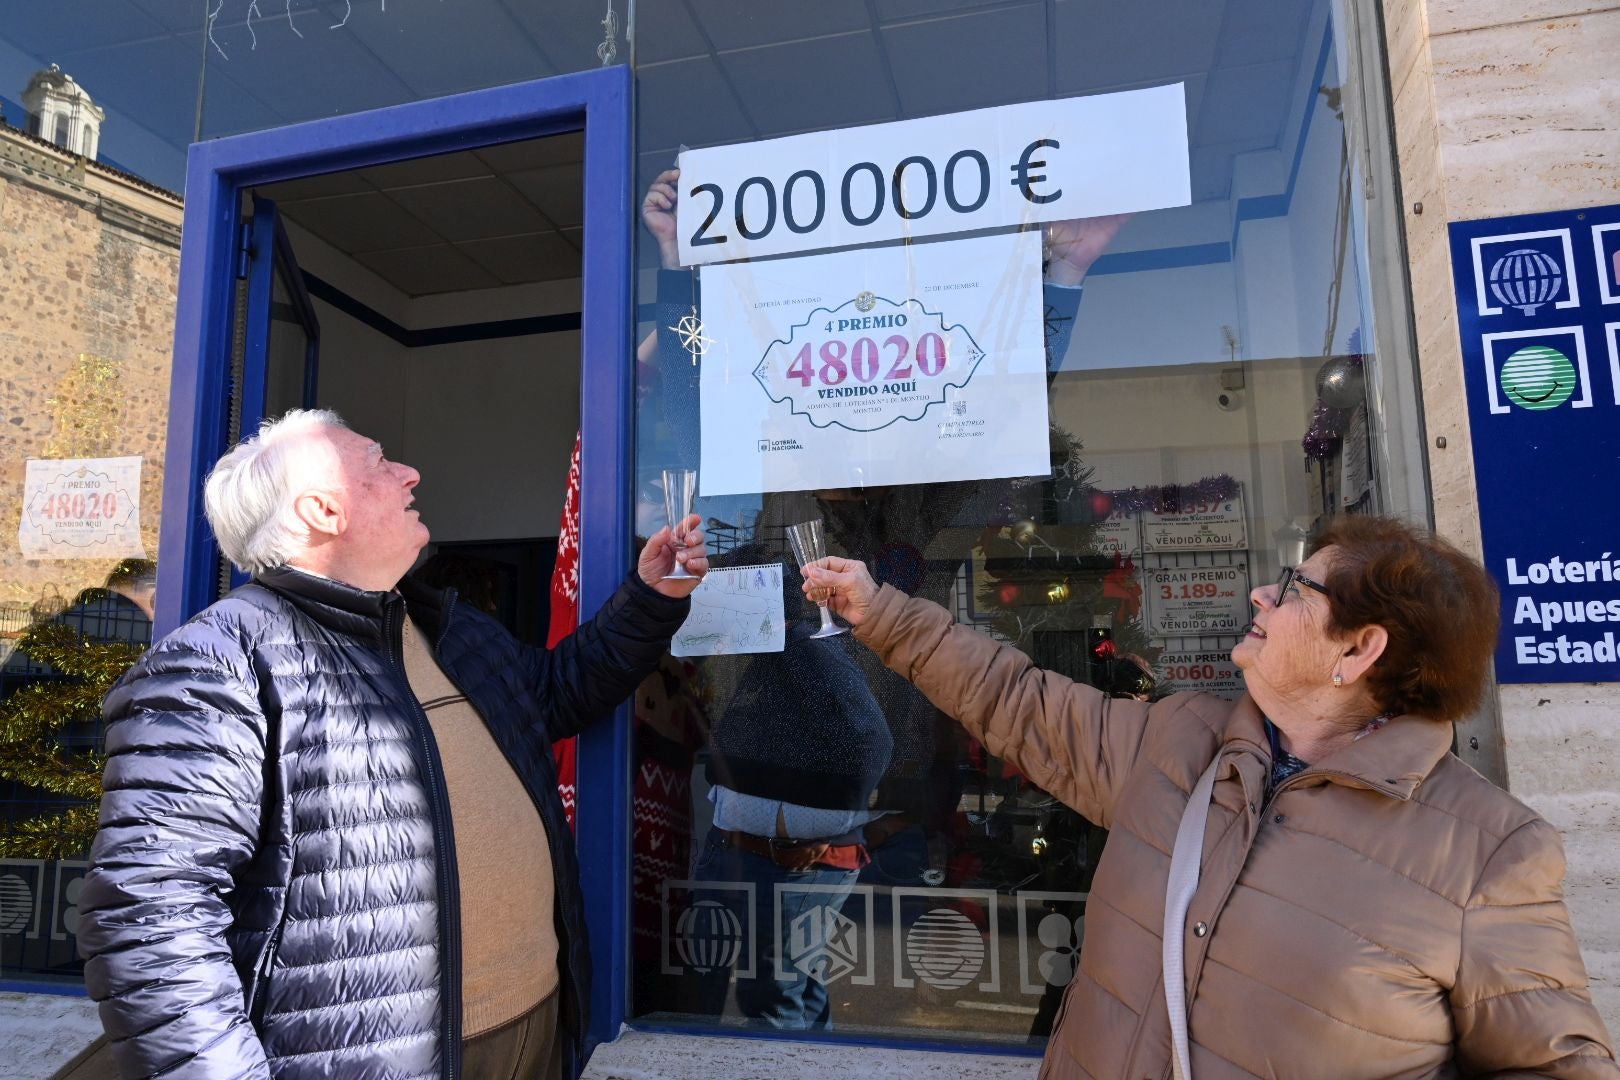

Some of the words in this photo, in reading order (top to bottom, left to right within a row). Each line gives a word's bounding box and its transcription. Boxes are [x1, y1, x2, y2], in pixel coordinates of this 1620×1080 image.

[1010, 138, 1063, 204] €
[943, 281, 980, 291] DICIEMBRE
[791, 296, 822, 305] NAVIDAD
[838, 313, 908, 332] PREMIO
[786, 332, 947, 387] 48020
[818, 385, 878, 399] VENDIDO
[882, 379, 917, 395] AQUÍ
[772, 438, 797, 446] LOTERÍA
[68, 480, 101, 489] PREMIO
[41, 492, 117, 520] 48020
[1155, 535, 1202, 545] VENDIDO
[1206, 533, 1232, 543] AQUÍ
[1155, 572, 1187, 583] GRAN
[1191, 570, 1236, 581] PREMIO
[1160, 620, 1207, 629] VENDIDO
[1211, 617, 1237, 628] AQUÍ
[1515, 631, 1620, 665] Estad
[1160, 654, 1192, 664] GRAN
[1195, 653, 1232, 663] PREMI
